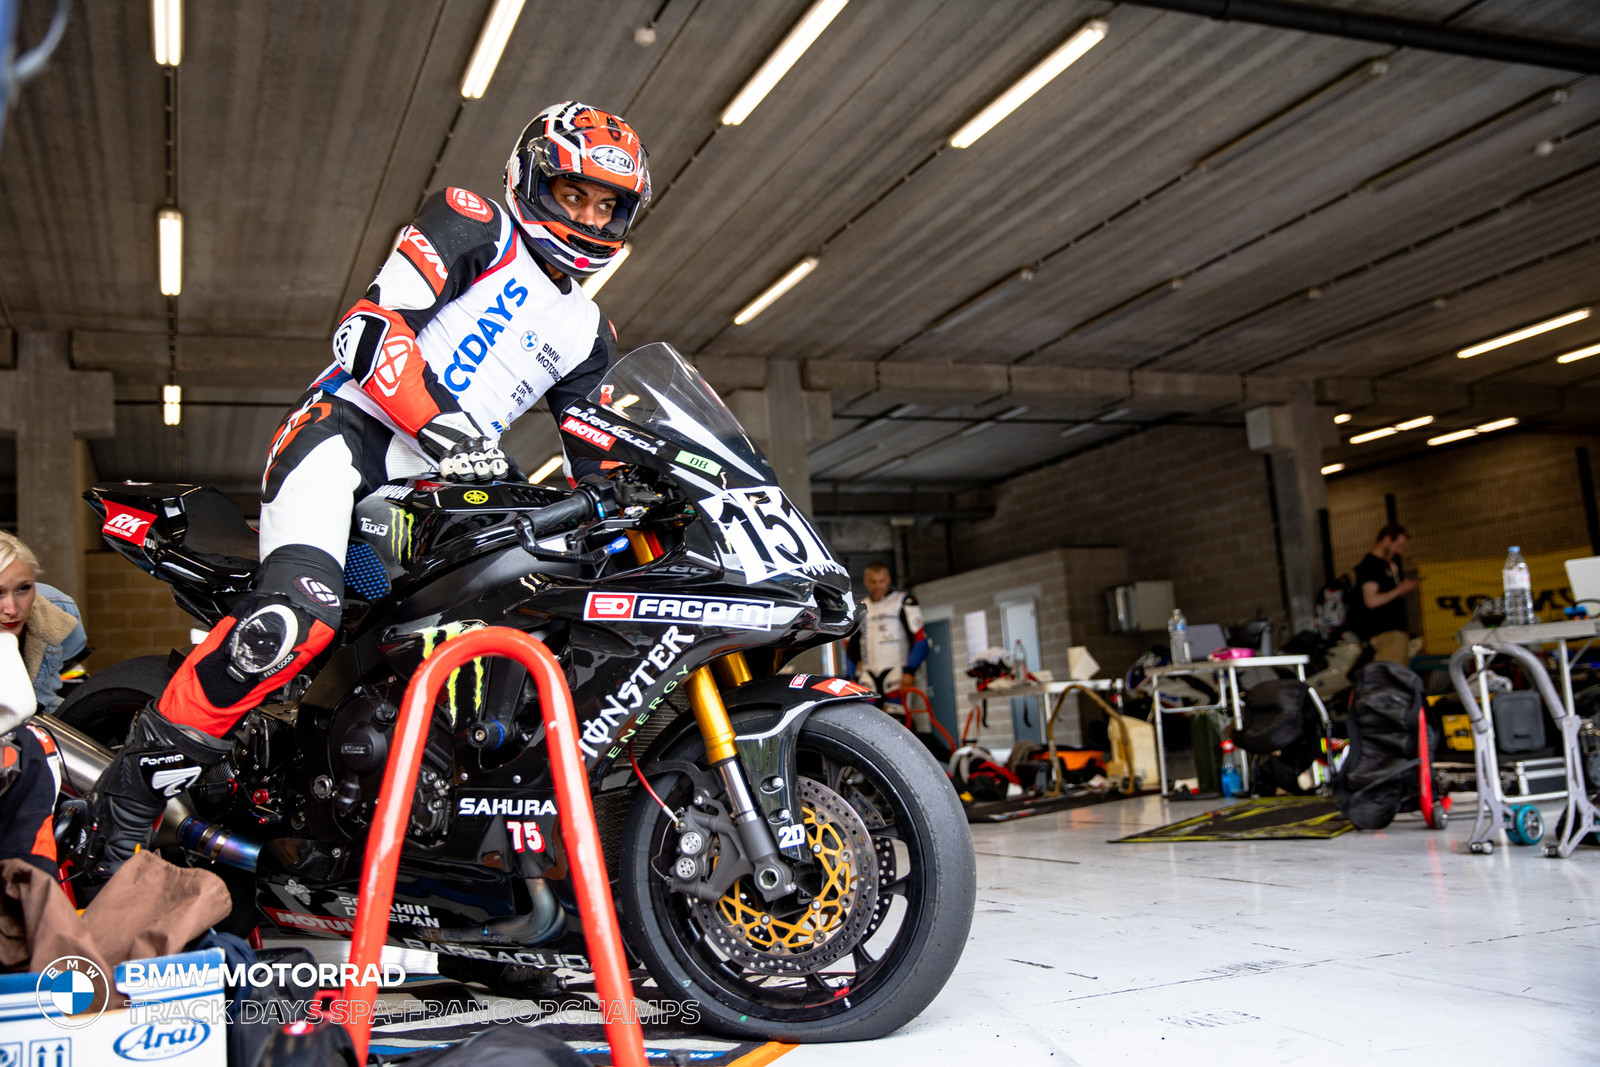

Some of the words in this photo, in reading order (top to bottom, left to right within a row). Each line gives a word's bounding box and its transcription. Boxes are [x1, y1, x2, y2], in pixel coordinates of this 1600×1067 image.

[591, 148, 631, 169] Arai
[443, 277, 529, 396] CKDAYS
[541, 342, 561, 363] BMW
[563, 419, 612, 447] MOTUL
[565, 405, 658, 456] BARRACUDA
[689, 456, 709, 469] DB
[107, 513, 150, 533] RK
[263, 667, 279, 678] FEEL
[277, 653, 294, 669] GOOD
[607, 662, 689, 759] ENERGY
[458, 797, 558, 816] SAKURA
[506, 820, 546, 854] 75
[402, 937, 594, 970] BARRACUD
[120, 1021, 198, 1055] Arai
